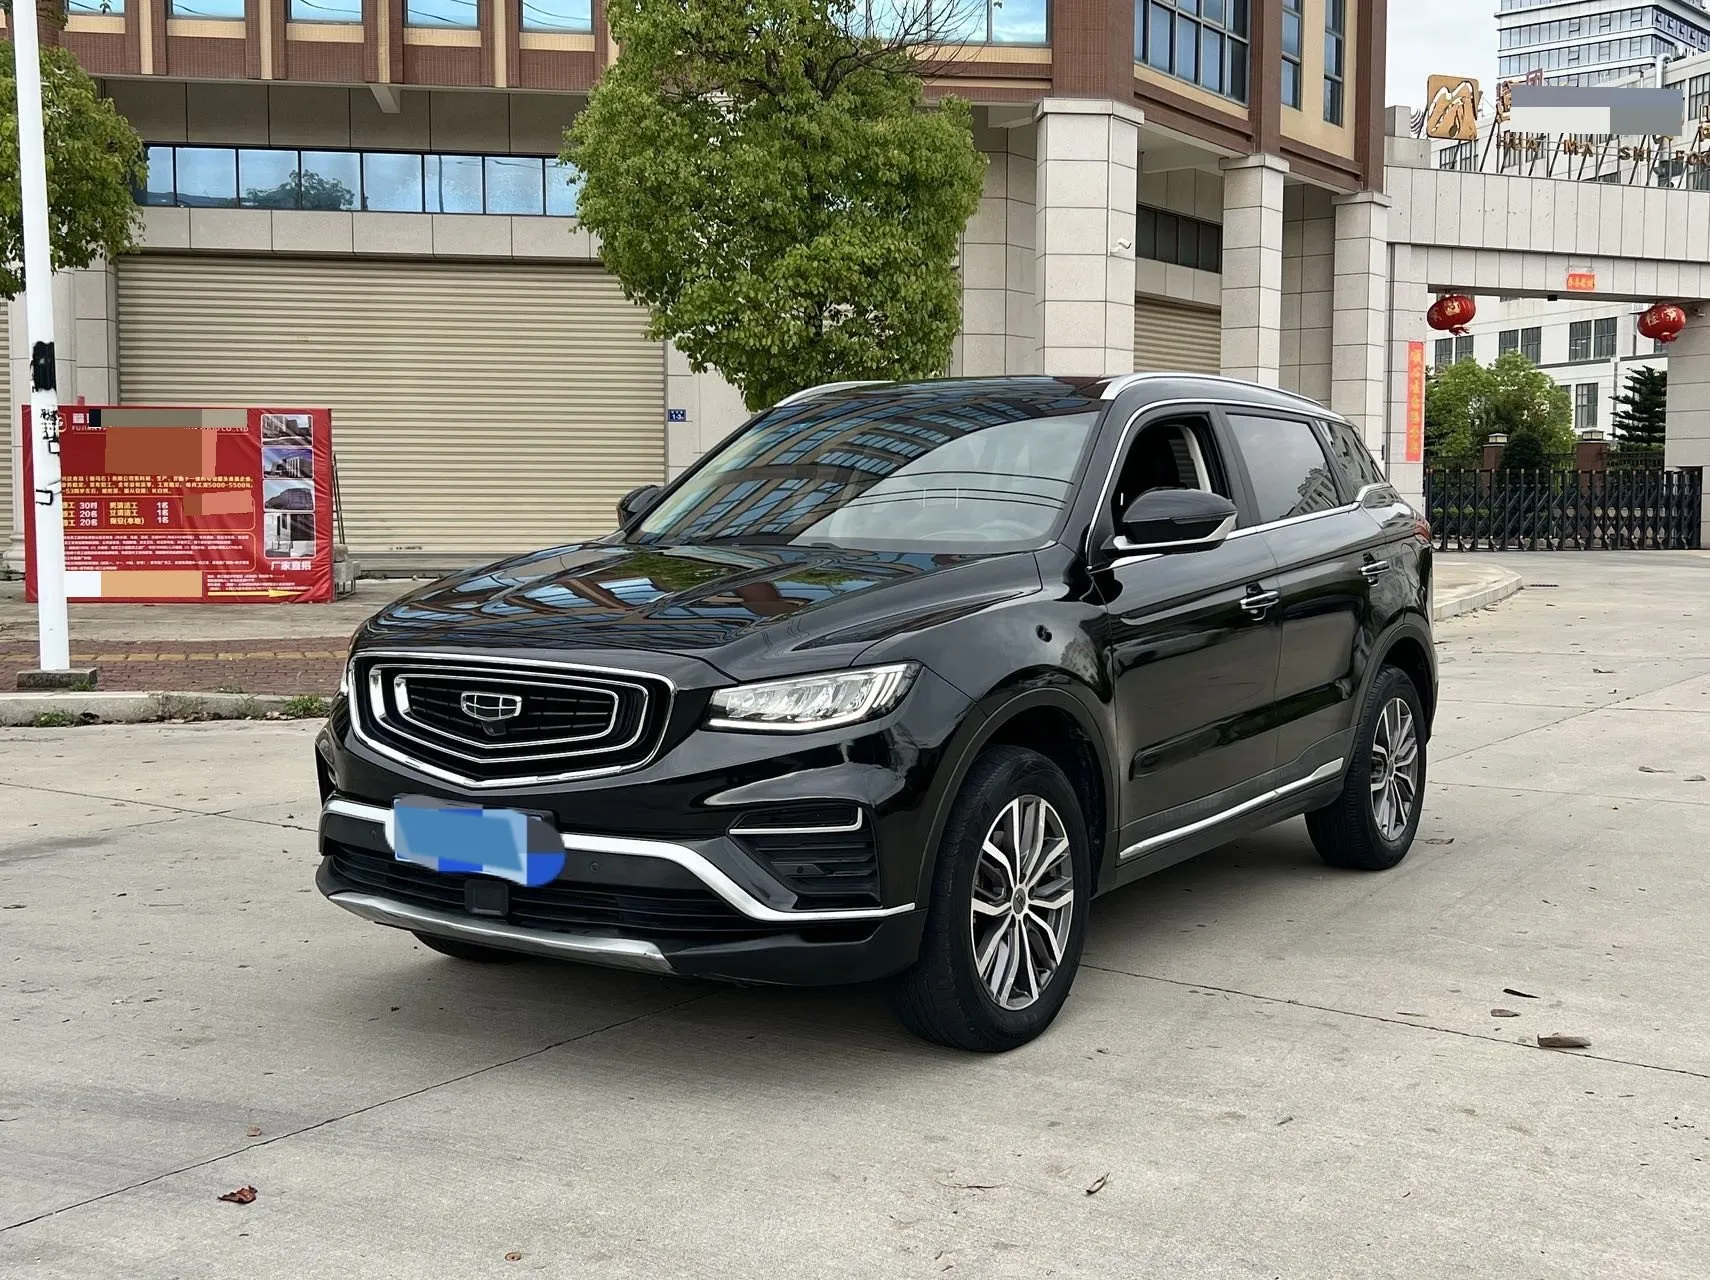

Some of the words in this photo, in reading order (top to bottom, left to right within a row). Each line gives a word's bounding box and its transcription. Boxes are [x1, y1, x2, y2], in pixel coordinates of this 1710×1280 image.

[1564, 139, 1594, 157] MA
[1619, 146, 1651, 162] SHI
[271, 561, 311, 571] 厂家直招
